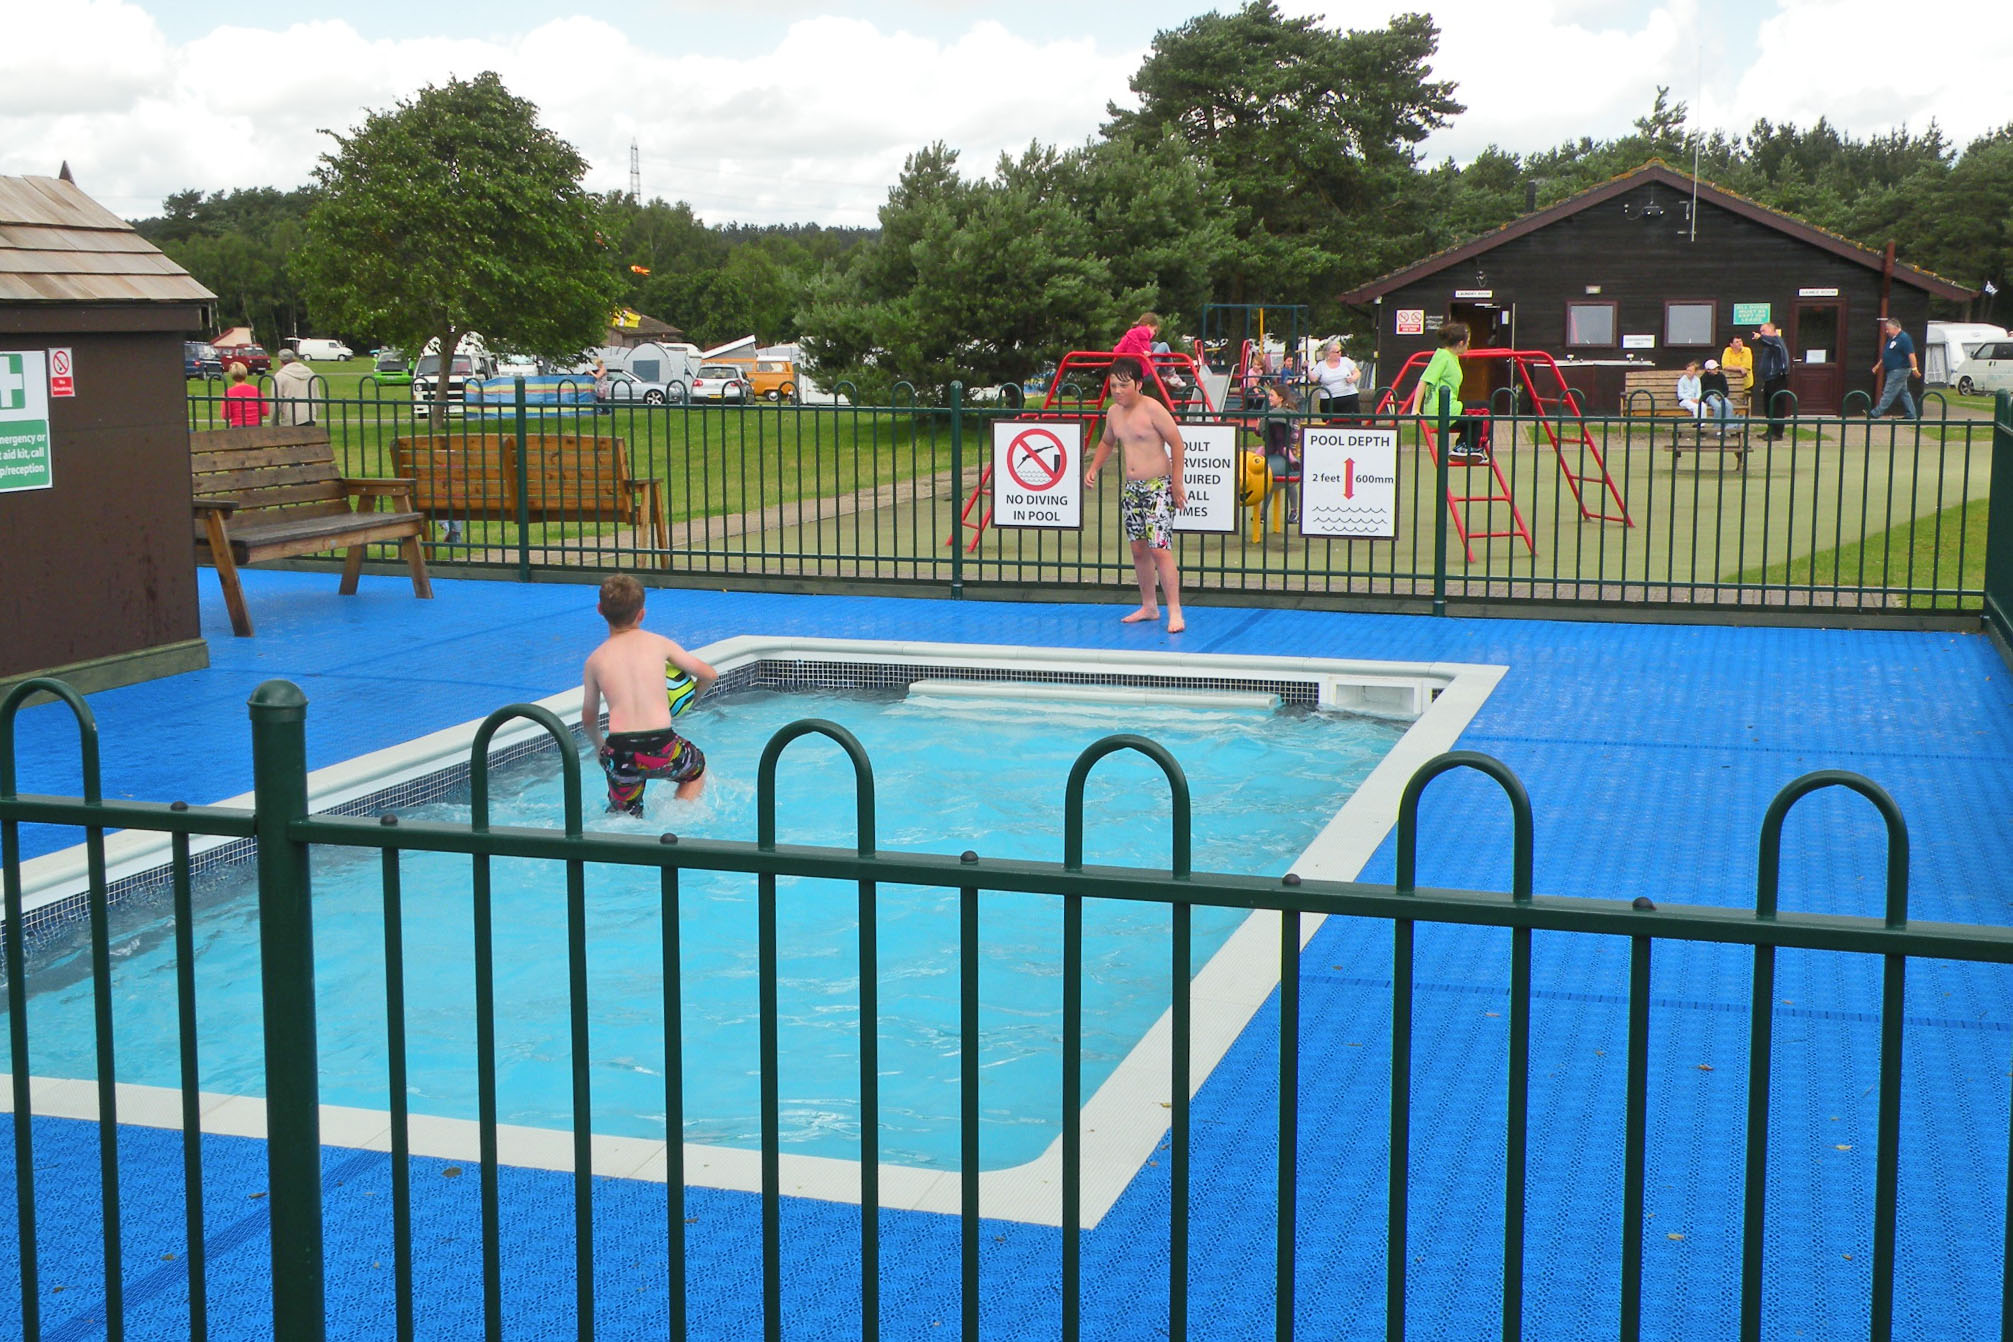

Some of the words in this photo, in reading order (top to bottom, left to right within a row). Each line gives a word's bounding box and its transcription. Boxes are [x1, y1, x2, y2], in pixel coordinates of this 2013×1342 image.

[0, 434, 36, 446] mergency
[36, 434, 46, 442] or
[1310, 435, 1344, 446] POOL
[1348, 436, 1390, 447] DEPTH
[1183, 441, 1210, 452] DULT
[3, 449, 16, 460] aid
[31, 447, 45, 458] call
[1184, 458, 1231, 469] RVISION
[0, 463, 45, 479] p/reception
[1184, 474, 1221, 485] UIRED
[1312, 473, 1318, 482] 2
[1320, 473, 1340, 482] feet
[1355, 474, 1394, 484] 600mm
[1006, 494, 1024, 505] NO
[1026, 494, 1068, 506] DIVING
[1187, 490, 1210, 501] ALL
[1013, 510, 1025, 521] IN
[1028, 511, 1061, 522] POOL
[1179, 506, 1208, 517] IMES
